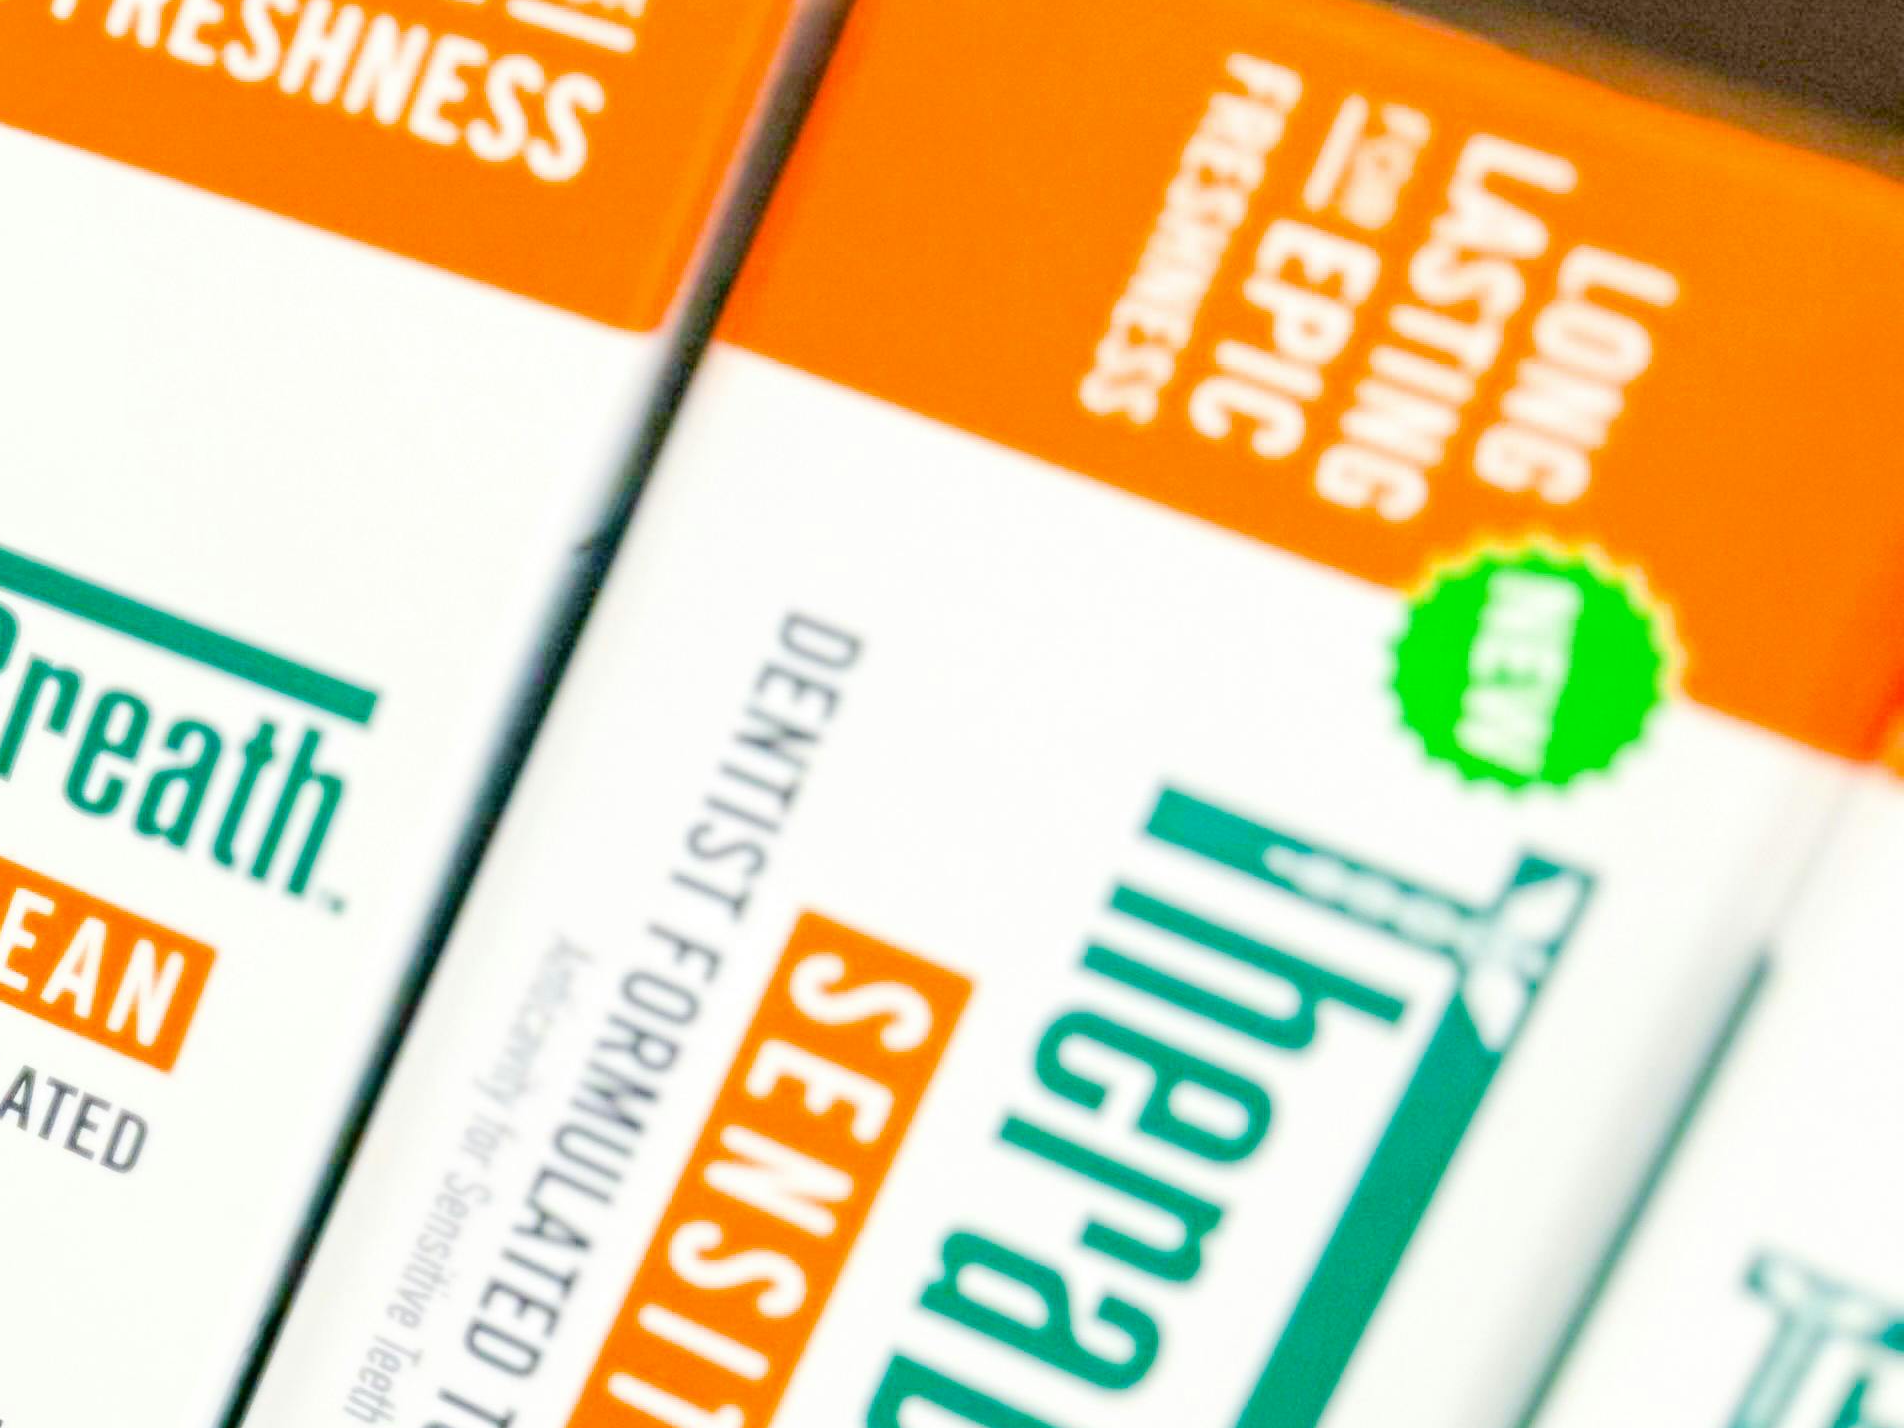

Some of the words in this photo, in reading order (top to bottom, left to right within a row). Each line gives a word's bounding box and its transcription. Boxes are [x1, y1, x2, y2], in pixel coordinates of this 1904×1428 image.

[1079, 52, 1303, 424] FRESHNESS
[1189, 219, 1381, 458] EPIC
[1315, 132, 1578, 521] LASTING
[1472, 246, 1678, 504] LONG
[670, 611, 864, 922] DENTIST
[385, 1169, 492, 1331] Sensitive
[462, 921, 723, 1379] FORMULATED
[343, 1333, 421, 1428] Teeth
